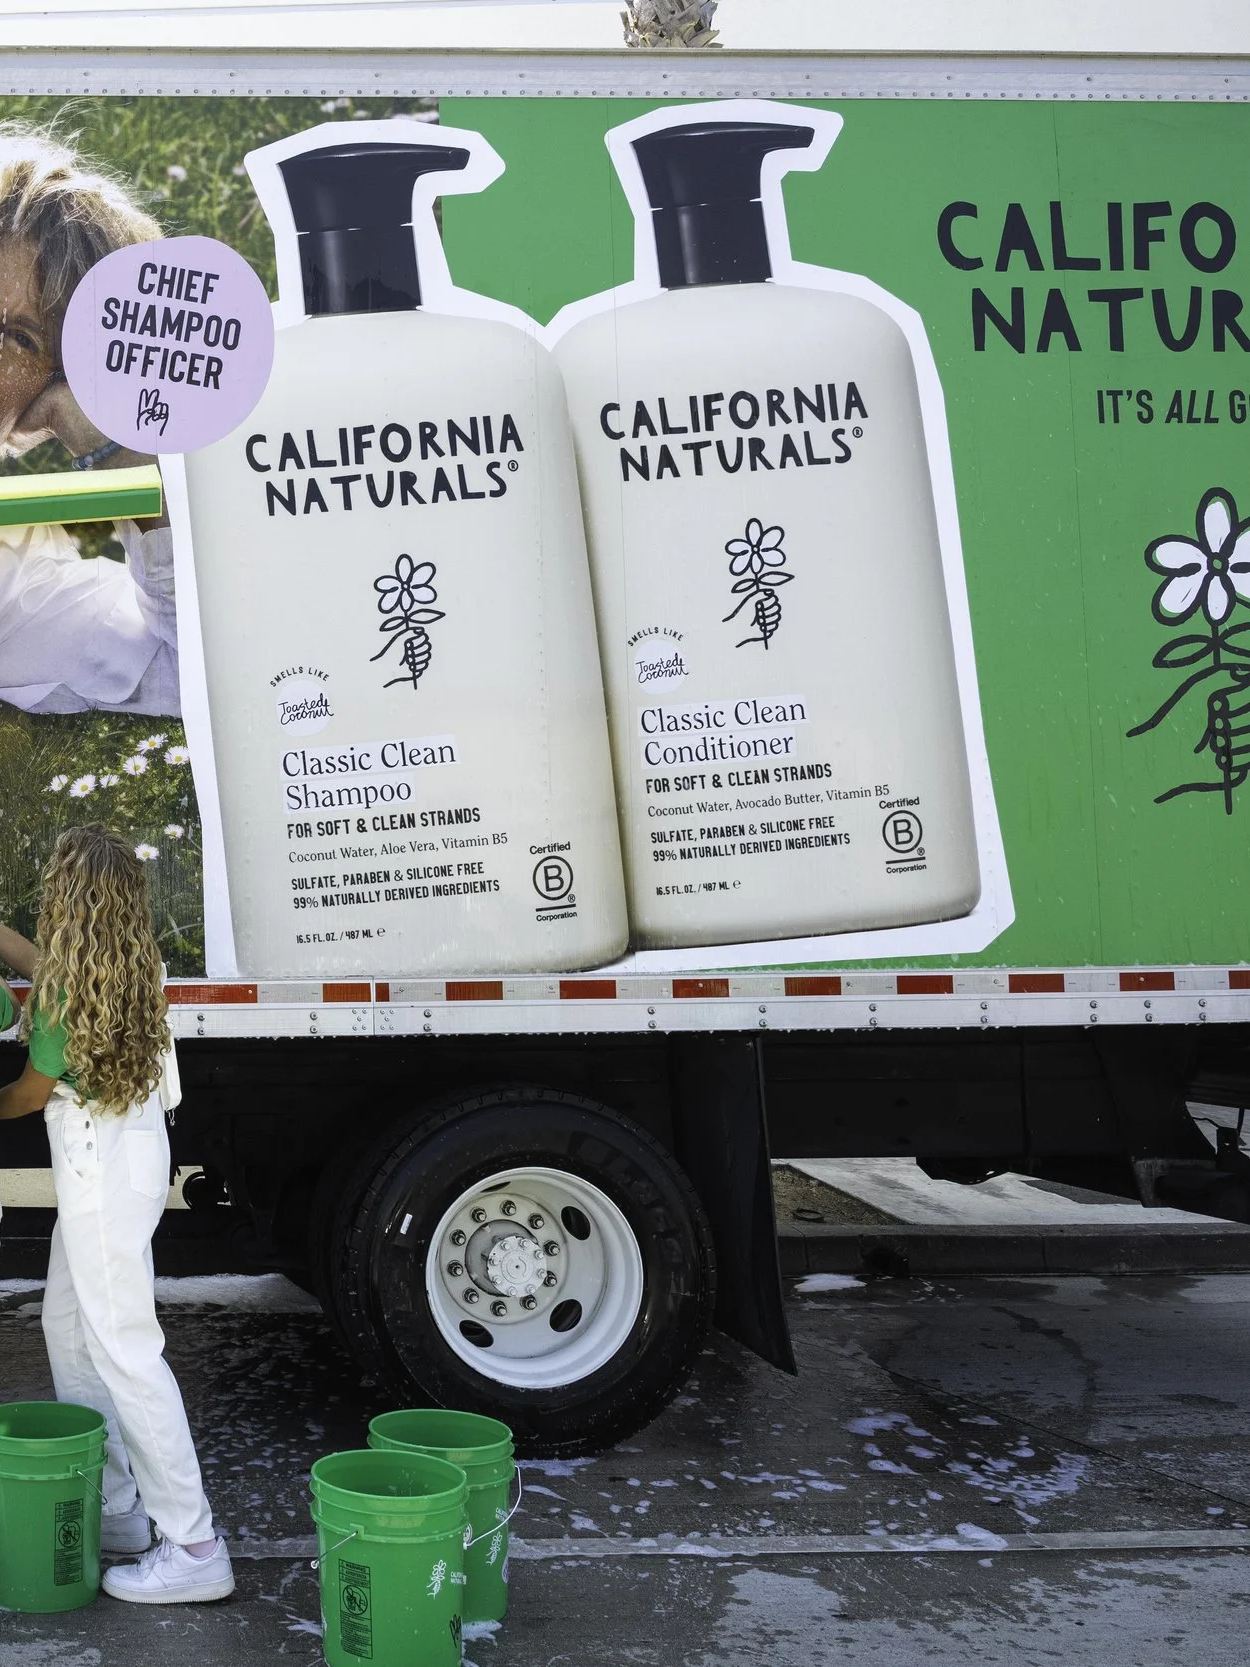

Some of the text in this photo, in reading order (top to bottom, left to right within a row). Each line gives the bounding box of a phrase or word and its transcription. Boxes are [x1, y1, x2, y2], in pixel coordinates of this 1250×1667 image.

[937, 200, 1237, 274] CALIFO
[137, 261, 220, 305] CHIEF
[101, 296, 242, 351] SHAMPOO
[971, 285, 1250, 354] NATUR
[105, 339, 224, 390] OFFICER
[600, 381, 869, 441] CALIFORNIA
[1096, 389, 1250, 425] IT'S ALL G
[245, 413, 525, 473] CALIFORNIA
[627, 626, 684, 648] SMELLS LIKE
[269, 666, 330, 688] SMELLS LIKE
[635, 652, 685, 675] Toasted
[278, 692, 331, 715] Toasted
[640, 699, 807, 734] Classic Clean
[282, 740, 457, 777] Classic Clean
[644, 734, 795, 766] Conditioner
[645, 763, 833, 794] FOR SOFT & CLEAN STRANDS
[285, 781, 412, 811] Shampoo
[647, 784, 890, 818] Coconut Water, Avocado Butter, Vitamin B5
[879, 796, 920, 811] Certified
[287, 807, 481, 839] FOR SOFT & CLEAN STRANDS
[650, 815, 836, 845] SULFATE, PARABEN & SILICONE FREE
[288, 832, 509, 864] Coconut Water, Aloe Vera, Vitamin B5
[529, 841, 571, 855] Certified
[652, 833, 851, 863] 99% NATURALLY DERIVED INGREDIENTS
[291, 861, 485, 891] SULFATE, PARABEN & SILICONE FREE
[885, 863, 928, 875] Corporation
[293, 879, 500, 910] 99% NATURALLY DERIVED INGREDIENTS
[702, 882, 717, 892] 487
[718, 880, 730, 891] ML
[535, 910, 578, 923] Corporation
[345, 929, 360, 940] 487
[361, 928, 374, 939] ML
